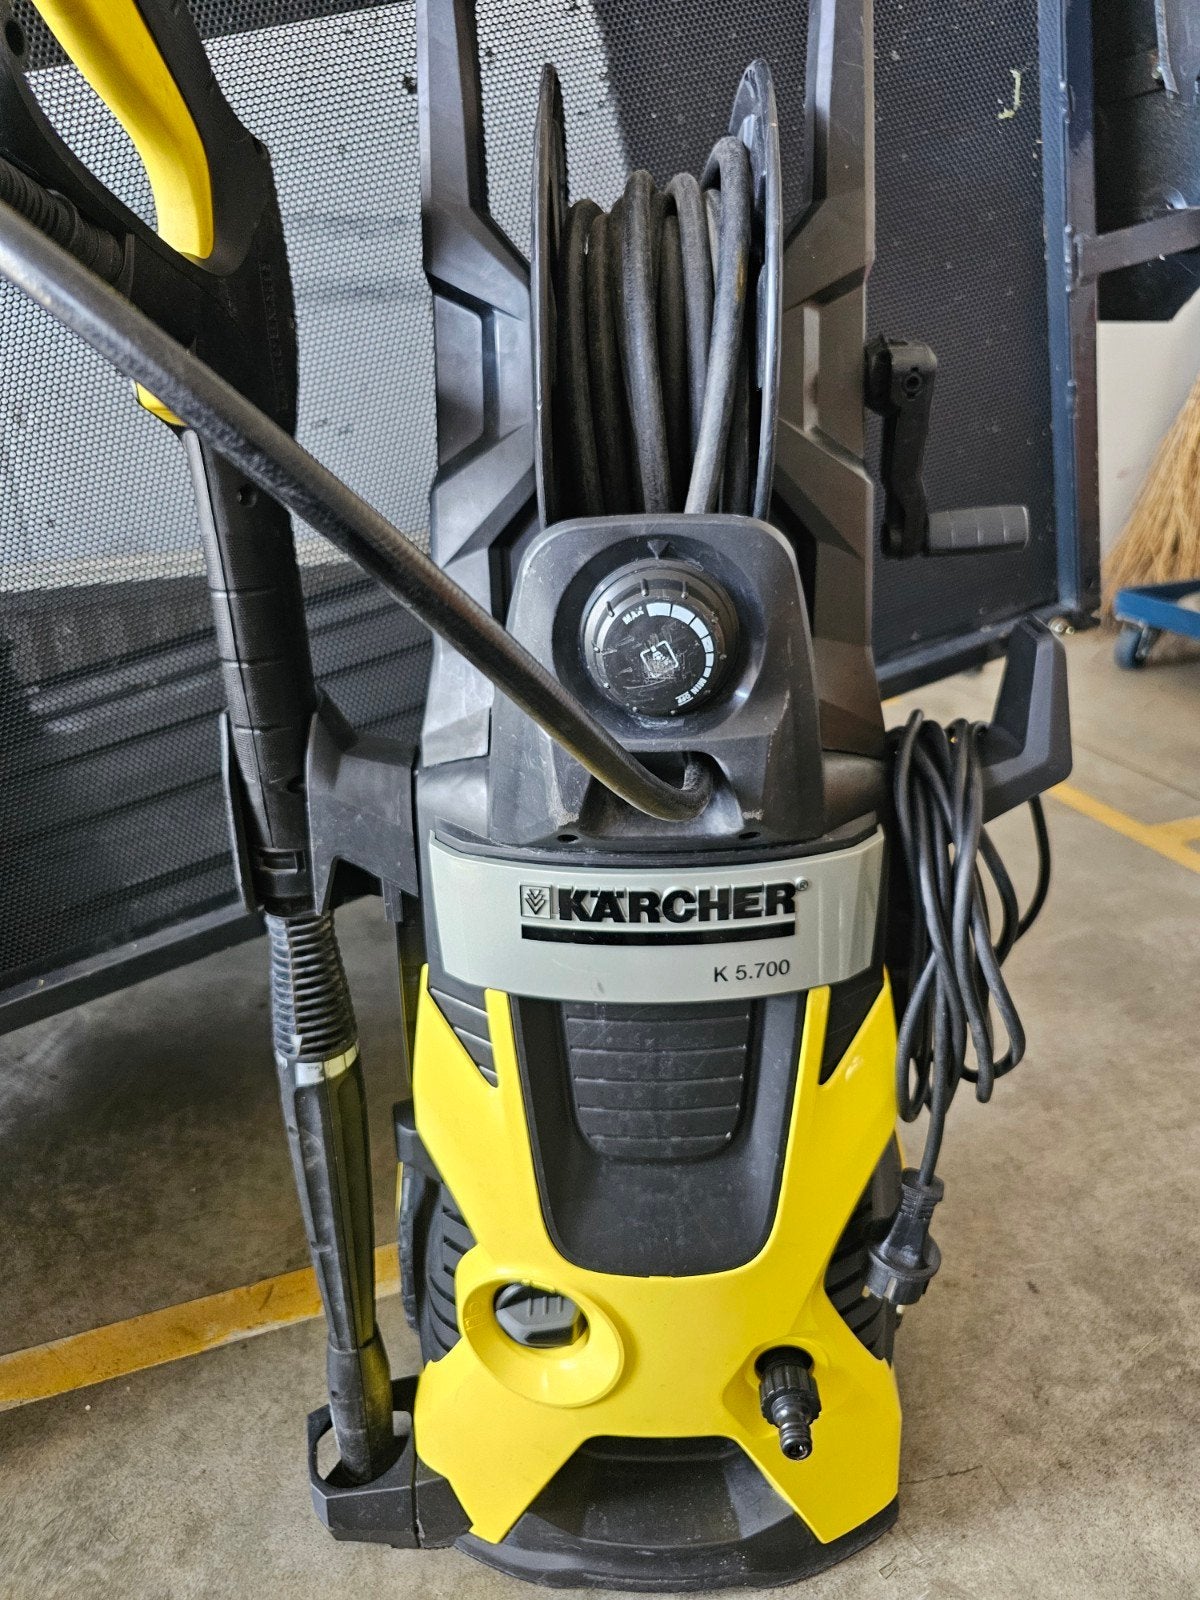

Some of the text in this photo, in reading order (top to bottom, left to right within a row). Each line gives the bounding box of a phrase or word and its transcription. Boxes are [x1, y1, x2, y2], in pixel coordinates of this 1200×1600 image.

[622, 605, 644, 625] MAX
[690, 677, 707, 695] MIN
[676, 691, 693, 705] OFF
[714, 958, 791, 982] K 5.700
